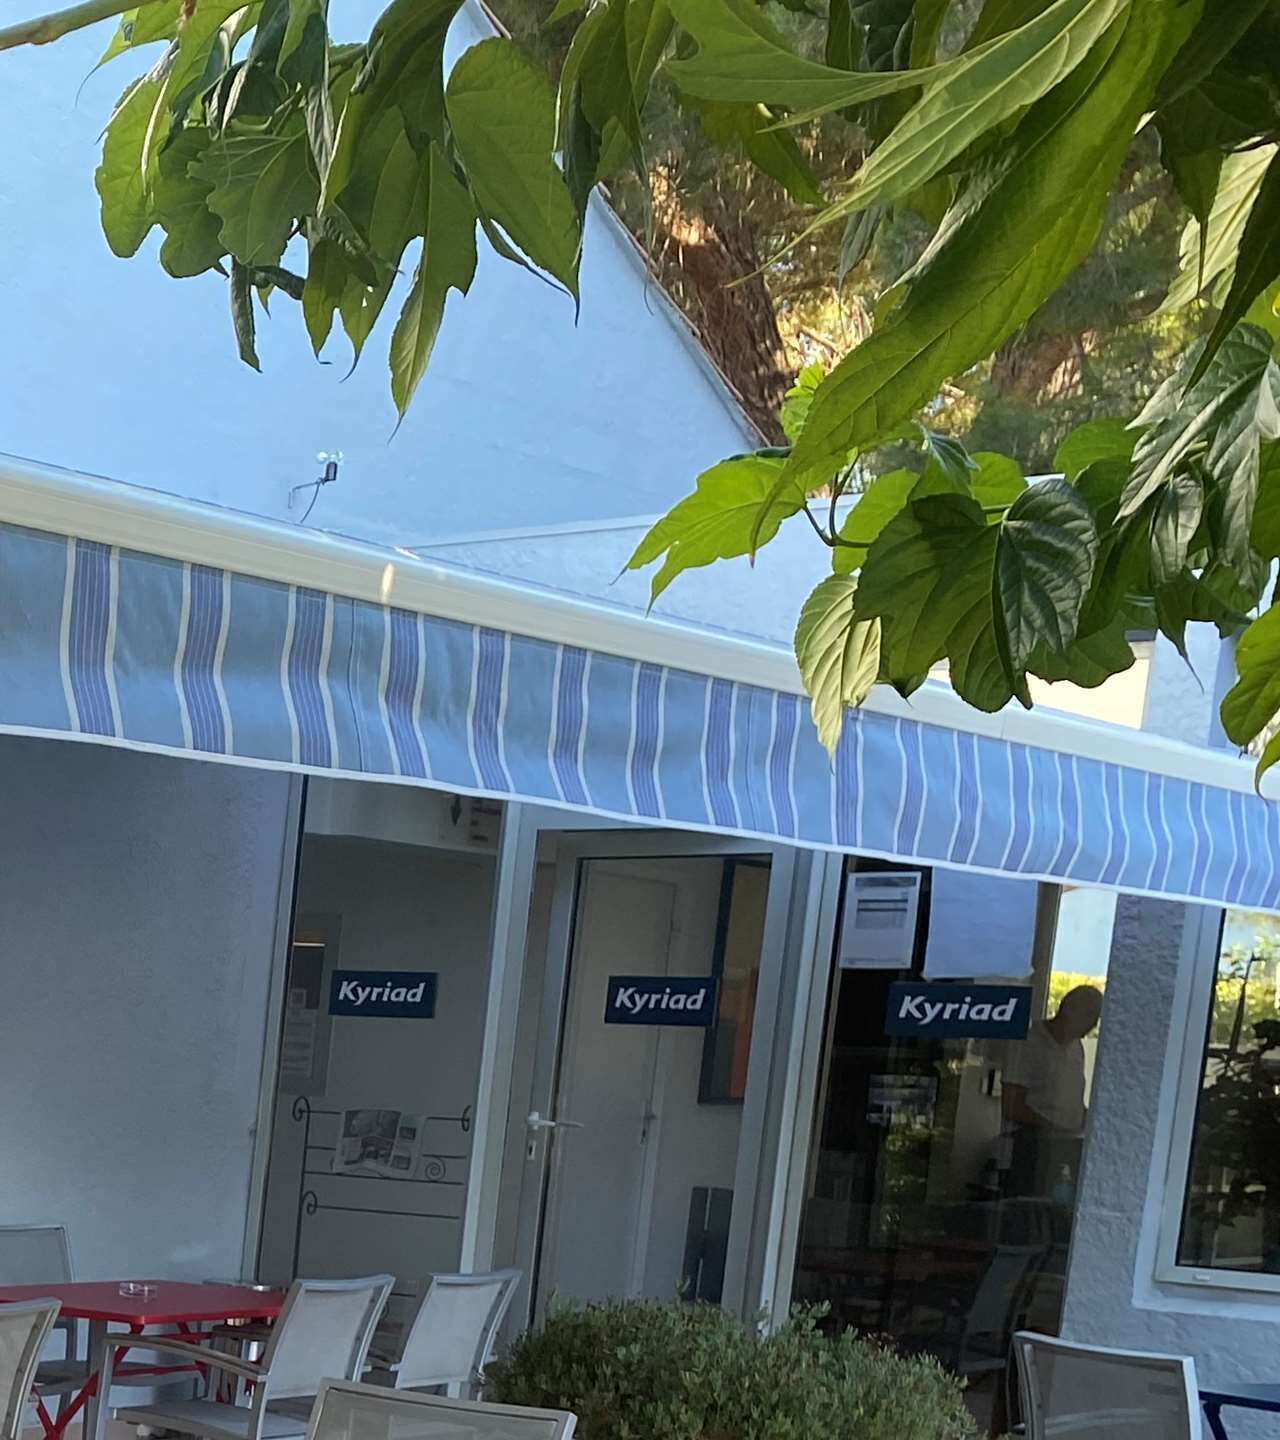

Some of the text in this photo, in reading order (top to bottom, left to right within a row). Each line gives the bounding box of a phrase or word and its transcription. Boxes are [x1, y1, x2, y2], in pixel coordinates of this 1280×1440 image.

[338, 980, 426, 1006] Kyriad
[614, 987, 706, 1014] Kyriad
[898, 996, 1018, 1025] Kyriad
